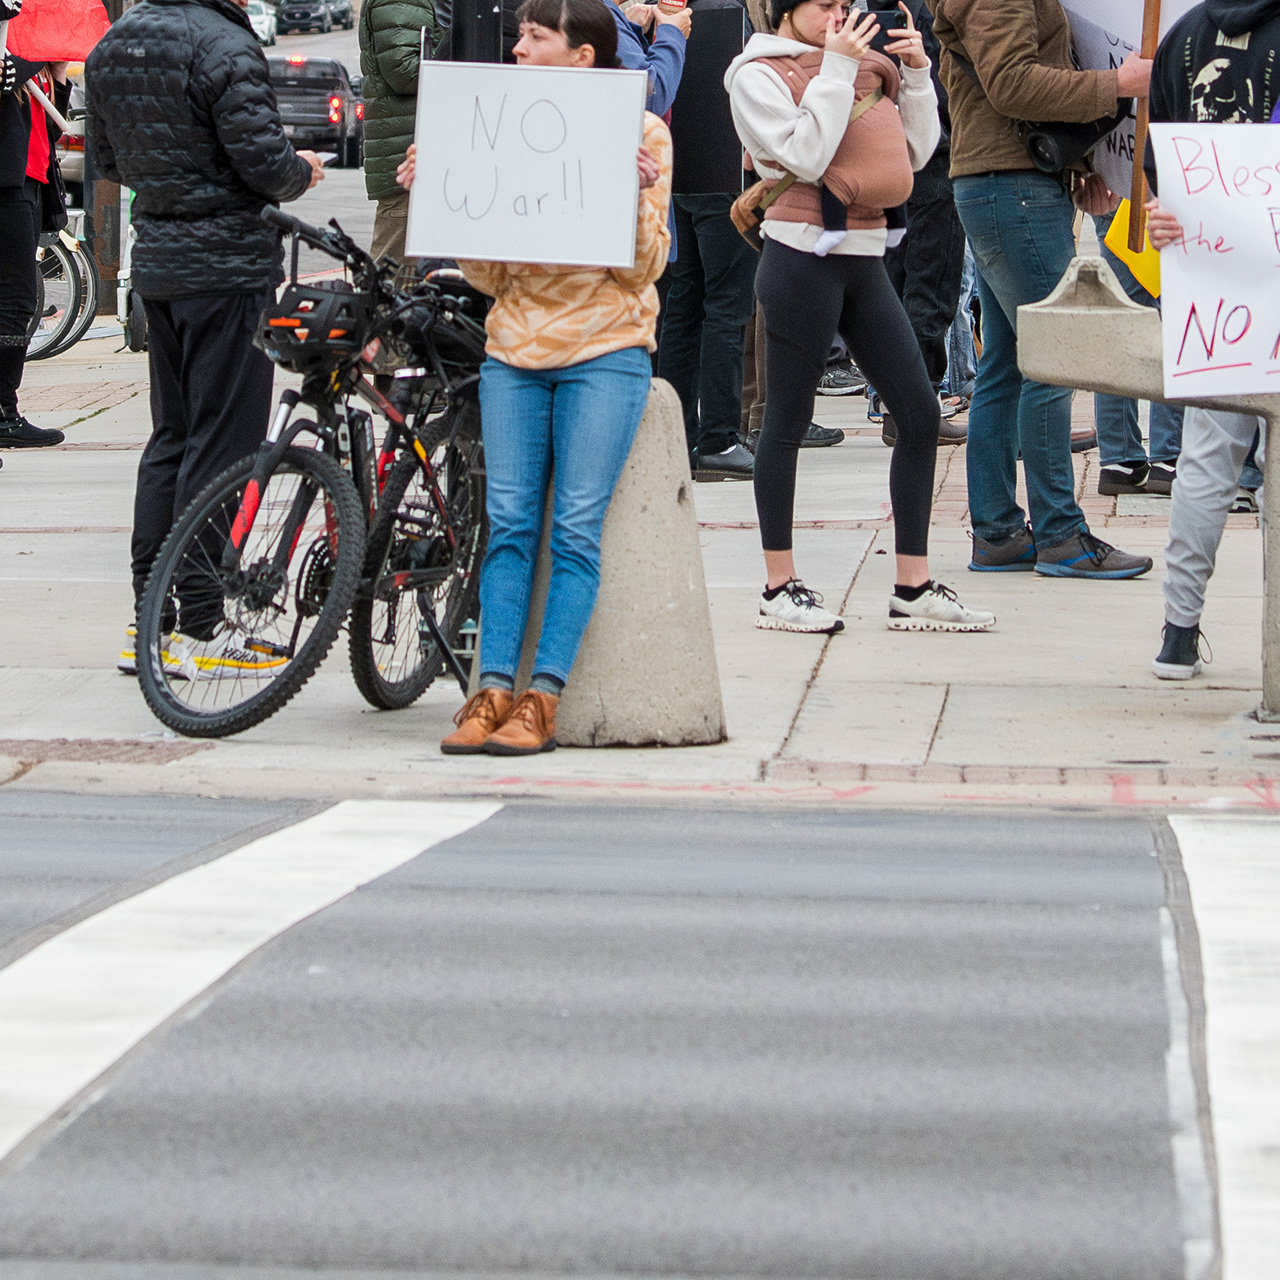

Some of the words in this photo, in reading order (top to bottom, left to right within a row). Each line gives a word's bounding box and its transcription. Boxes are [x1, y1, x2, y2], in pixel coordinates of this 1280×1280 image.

[471, 92, 567, 154] NO
[1263, 89, 1272, 123] WICKE
[443, 158, 584, 221] War!!
[1175, 220, 1234, 255] the
[1176, 297, 1252, 366] NO
